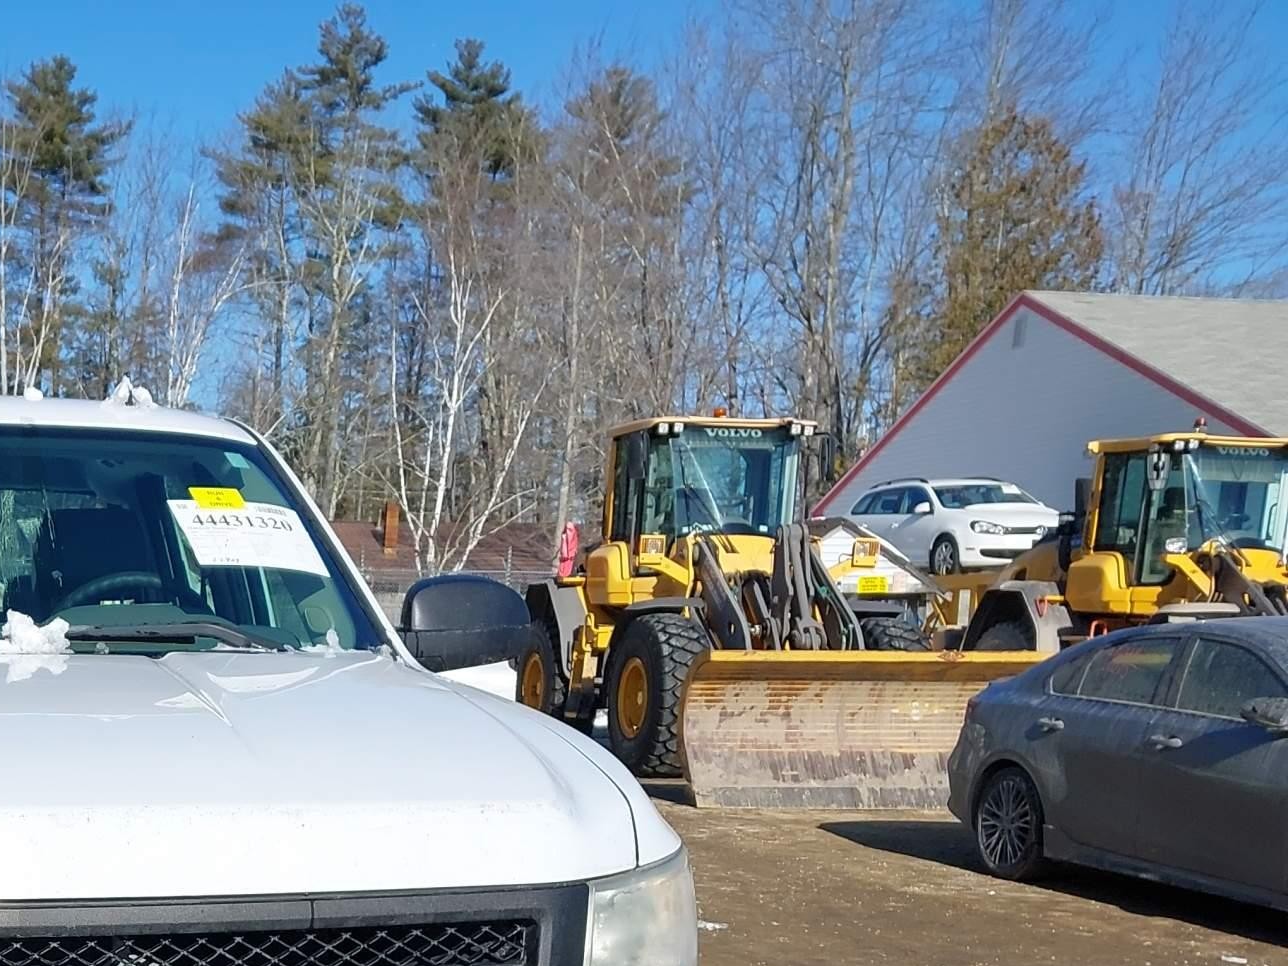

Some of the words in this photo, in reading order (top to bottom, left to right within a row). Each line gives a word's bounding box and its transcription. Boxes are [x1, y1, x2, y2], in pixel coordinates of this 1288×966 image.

[704, 428, 762, 438] VOLVO
[1216, 446, 1270, 457] VOLVO
[192, 513, 293, 532] 44431320
